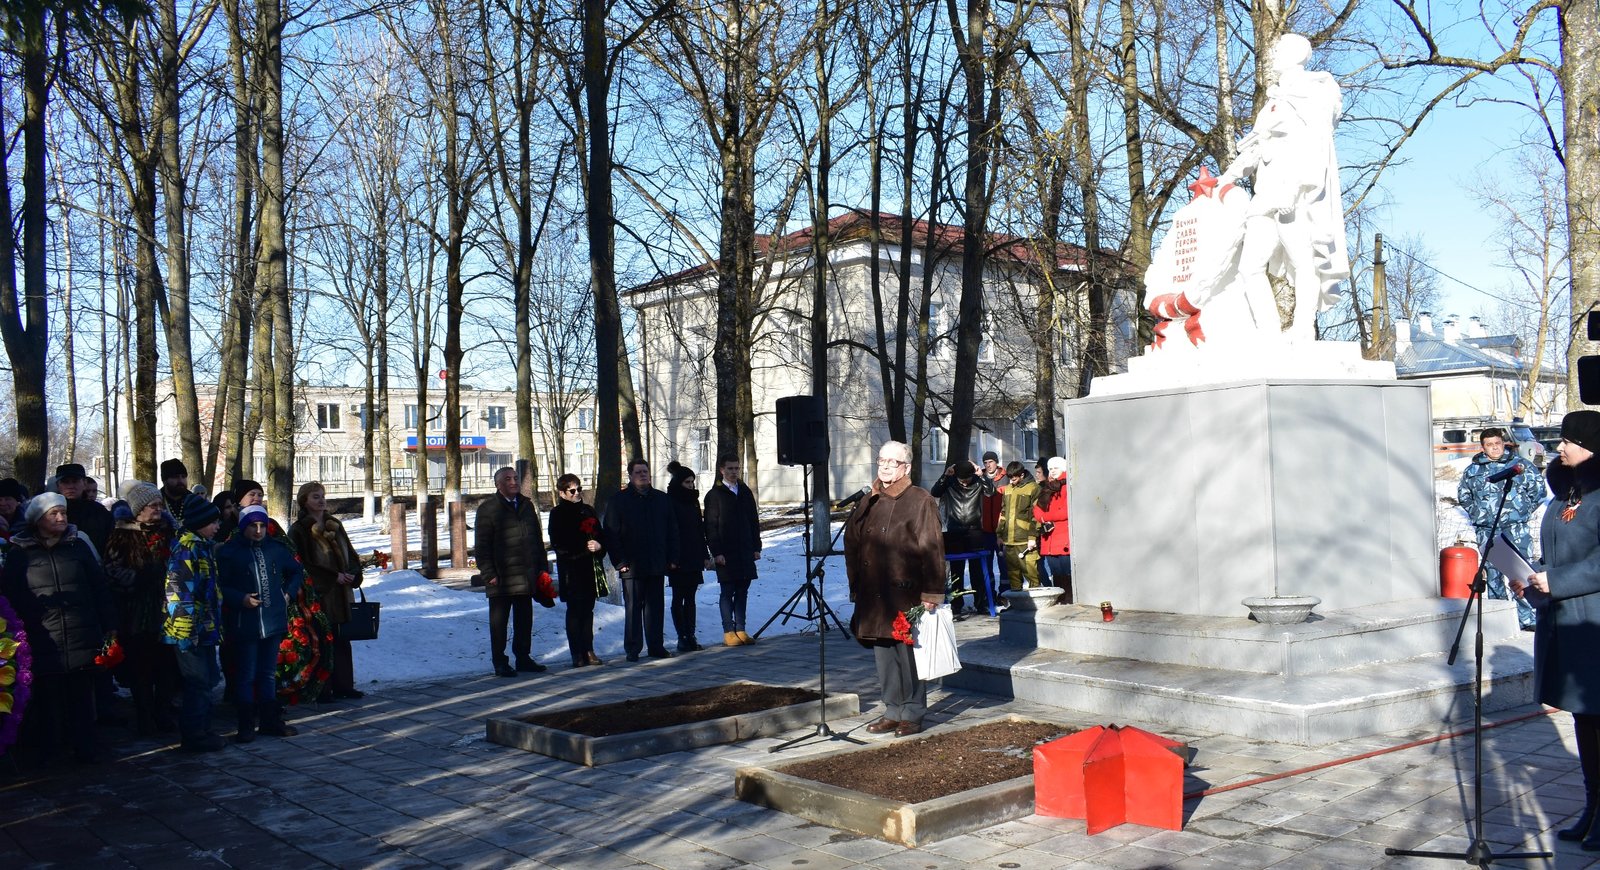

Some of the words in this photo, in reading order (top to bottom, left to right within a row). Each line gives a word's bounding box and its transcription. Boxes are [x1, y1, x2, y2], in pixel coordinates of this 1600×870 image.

[1176, 218, 1197, 229] ВЕЧНАЯ
[1176, 228, 1196, 239] СЛАВА
[425, 437, 473, 446] ОЛИЯ
